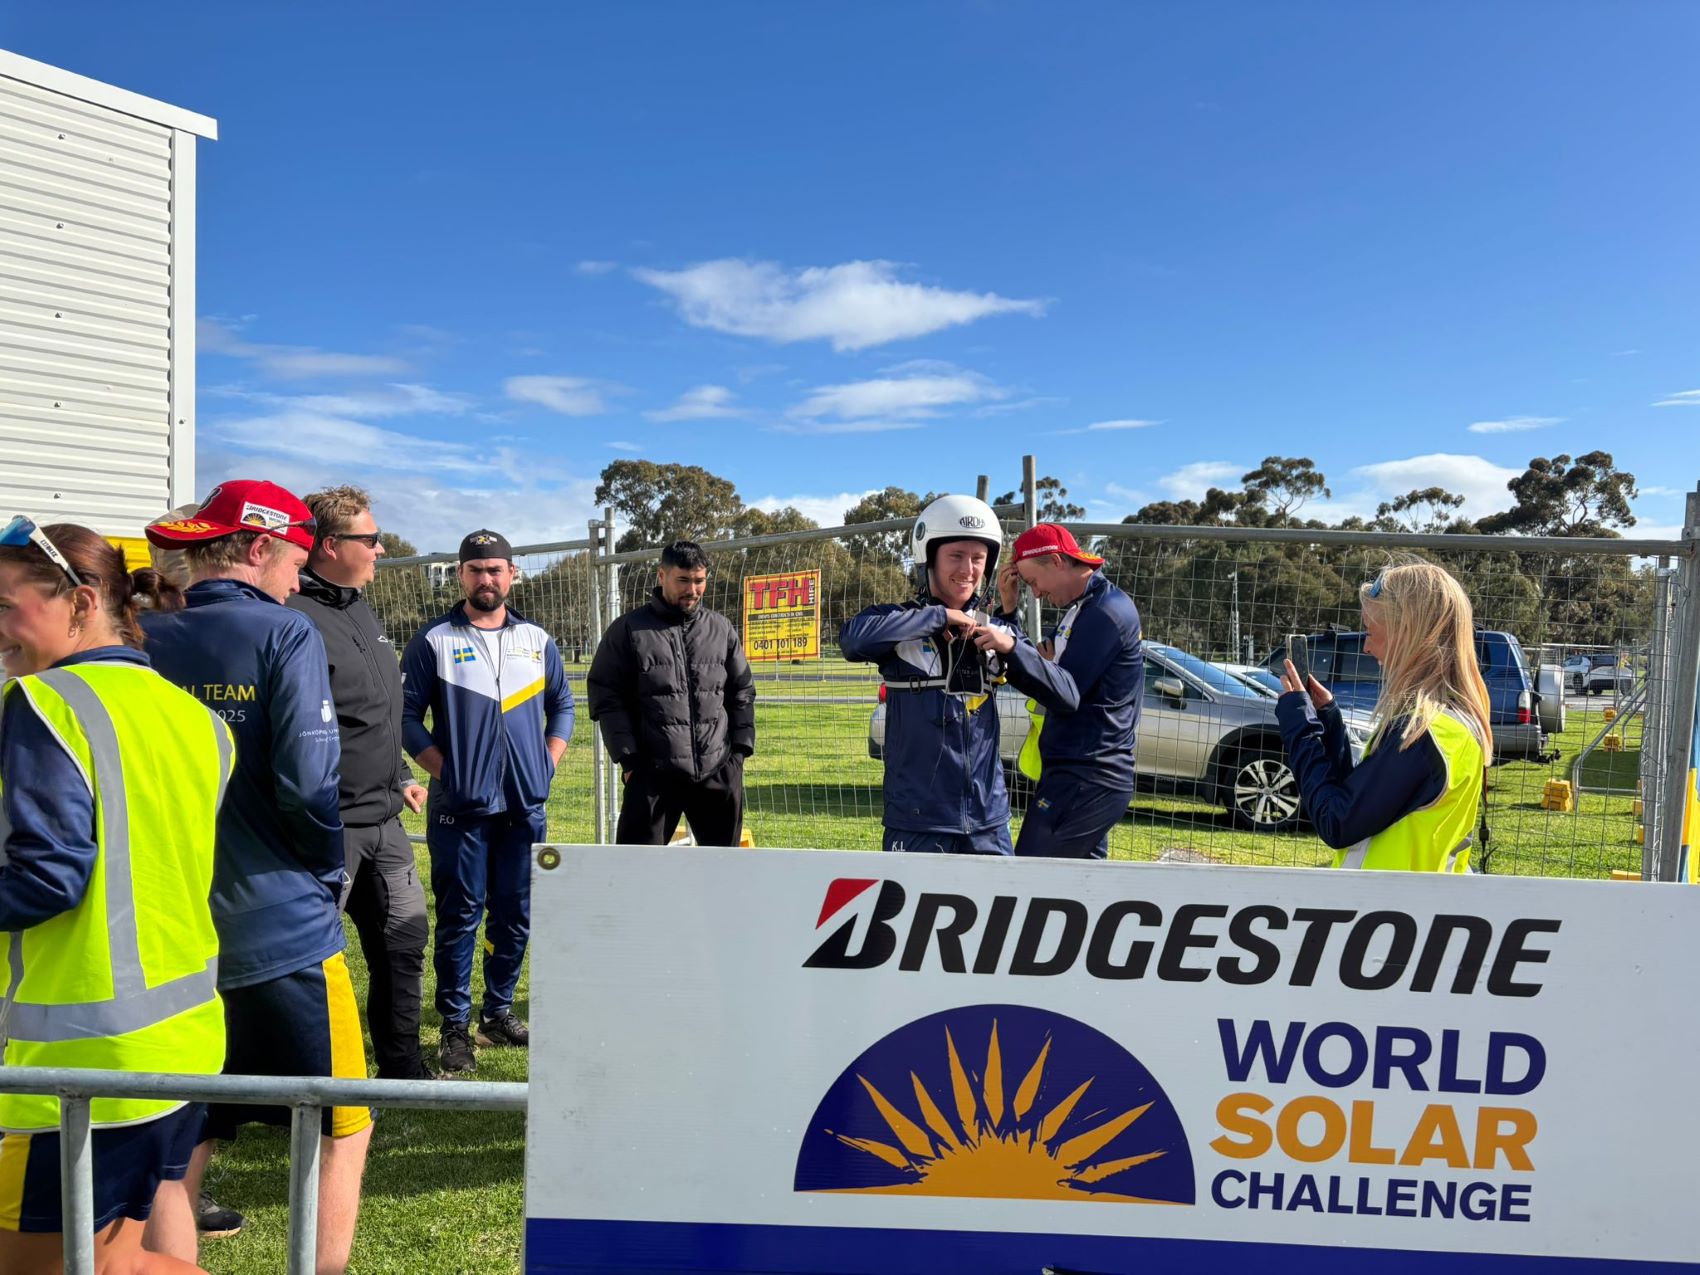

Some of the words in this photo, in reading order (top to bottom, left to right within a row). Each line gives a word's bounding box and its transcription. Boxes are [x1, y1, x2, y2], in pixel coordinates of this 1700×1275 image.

[749, 578, 809, 610] TFH
[754, 640, 773, 650] 0401
[793, 637, 808, 648] 189
[203, 684, 256, 701] TEAM
[217, 709, 246, 722] 025
[801, 877, 1562, 998] BRIDGESTONE
[1217, 1018, 1547, 1096] WORLD
[1208, 1092, 1538, 1172] SOLAR
[1211, 1169, 1533, 1223] CHALLENGE
